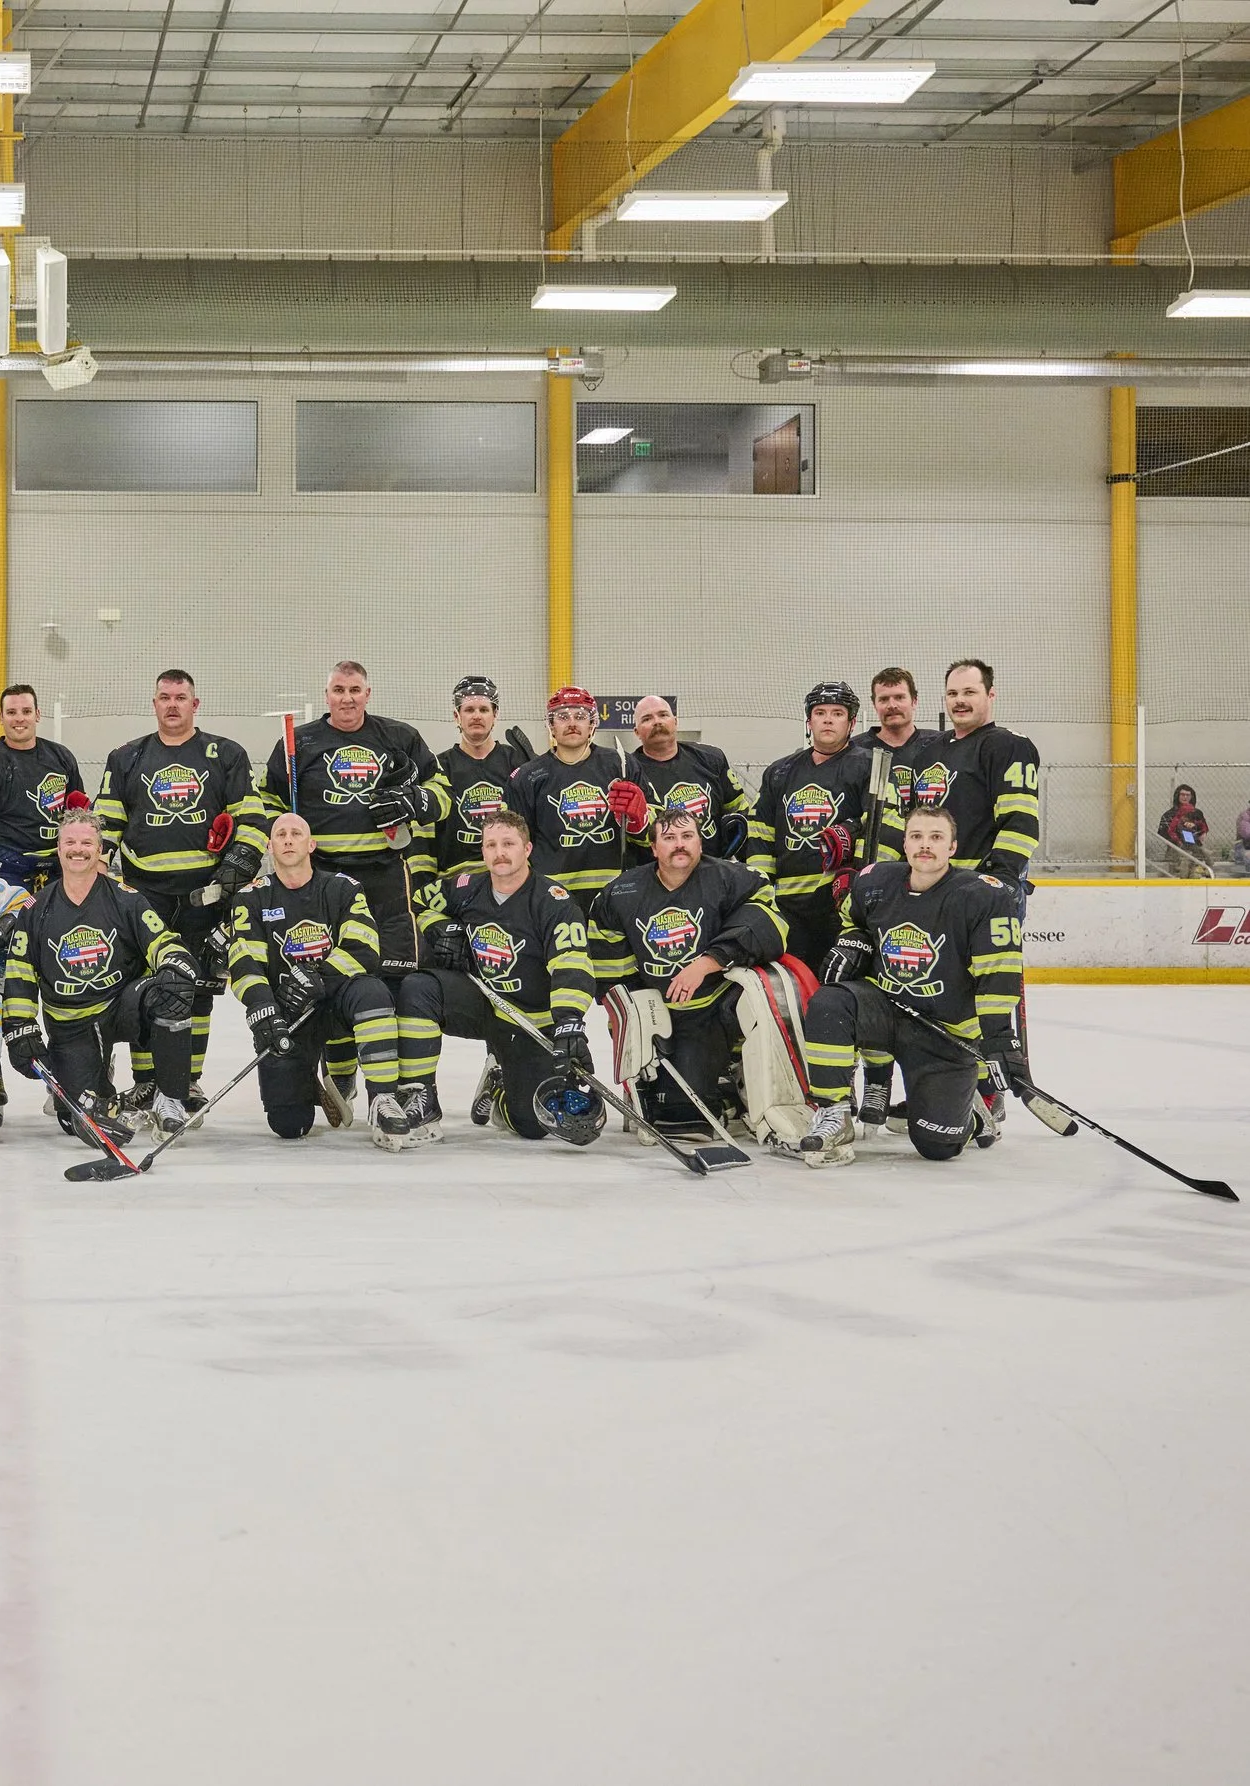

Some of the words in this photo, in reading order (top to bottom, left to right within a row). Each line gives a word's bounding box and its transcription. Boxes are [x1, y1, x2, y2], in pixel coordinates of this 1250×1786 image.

[205, 743, 218, 758] C
[340, 750, 371, 759] NASHVILLE
[160, 769, 192, 779] NASHVILLE
[1004, 761, 1038, 791] 40
[468, 786, 499, 798] NASHVILLE
[565, 787, 597, 798] NASHVILLE
[795, 790, 829, 801] NASHVILLE
[141, 909, 165, 934] 8
[655, 911, 687, 925] NASHVILLE
[65, 931, 100, 944] NASHVILLE
[290, 927, 324, 939] NASHVILLE
[478, 929, 509, 943] NASHVILLE
[554, 922, 587, 951] 20
[890, 931, 926, 942] NASHVILLE
[1022, 930, 1065, 942] essee
[837, 938, 874, 953] Reebok
[488, 992, 518, 1016] EASTON
[916, 1118, 964, 1135] BAUER
